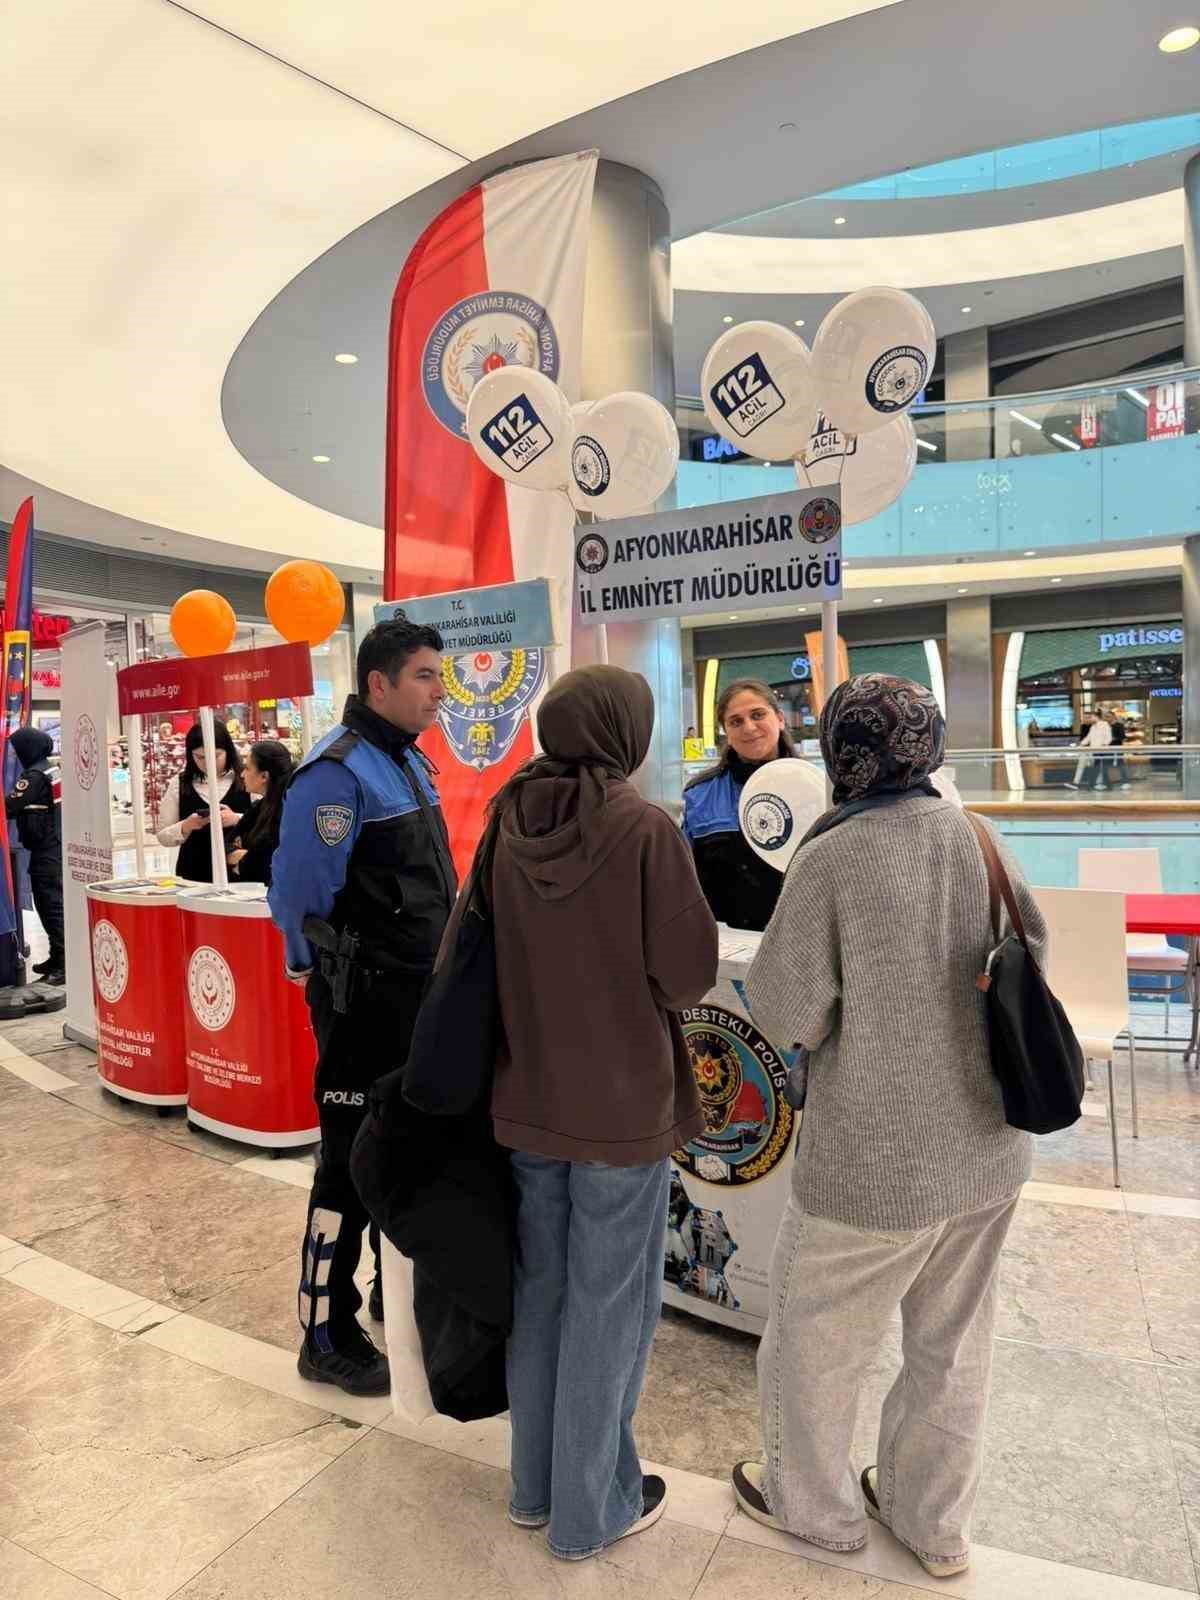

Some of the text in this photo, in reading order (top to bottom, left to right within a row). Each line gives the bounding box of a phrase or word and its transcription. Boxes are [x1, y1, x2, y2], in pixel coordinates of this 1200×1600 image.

[717, 364, 763, 409] 112
[738, 397, 767, 422] ACİL
[489, 405, 533, 449] 112
[511, 436, 538, 459] ACİL
[812, 432, 840, 450] ACİL
[613, 513, 793, 564] AFYONKARAHİSAR
[579, 552, 841, 614] İL EMNİYET MÜDÜRLÜĞÜ
[480, 610, 516, 627] VALİLİĞİ
[458, 630, 512, 648] MÜDÜRLÜĞÜ
[1099, 627, 1184, 652] patisse
[682, 1007, 787, 1089] DESTEKLİ POLİS
